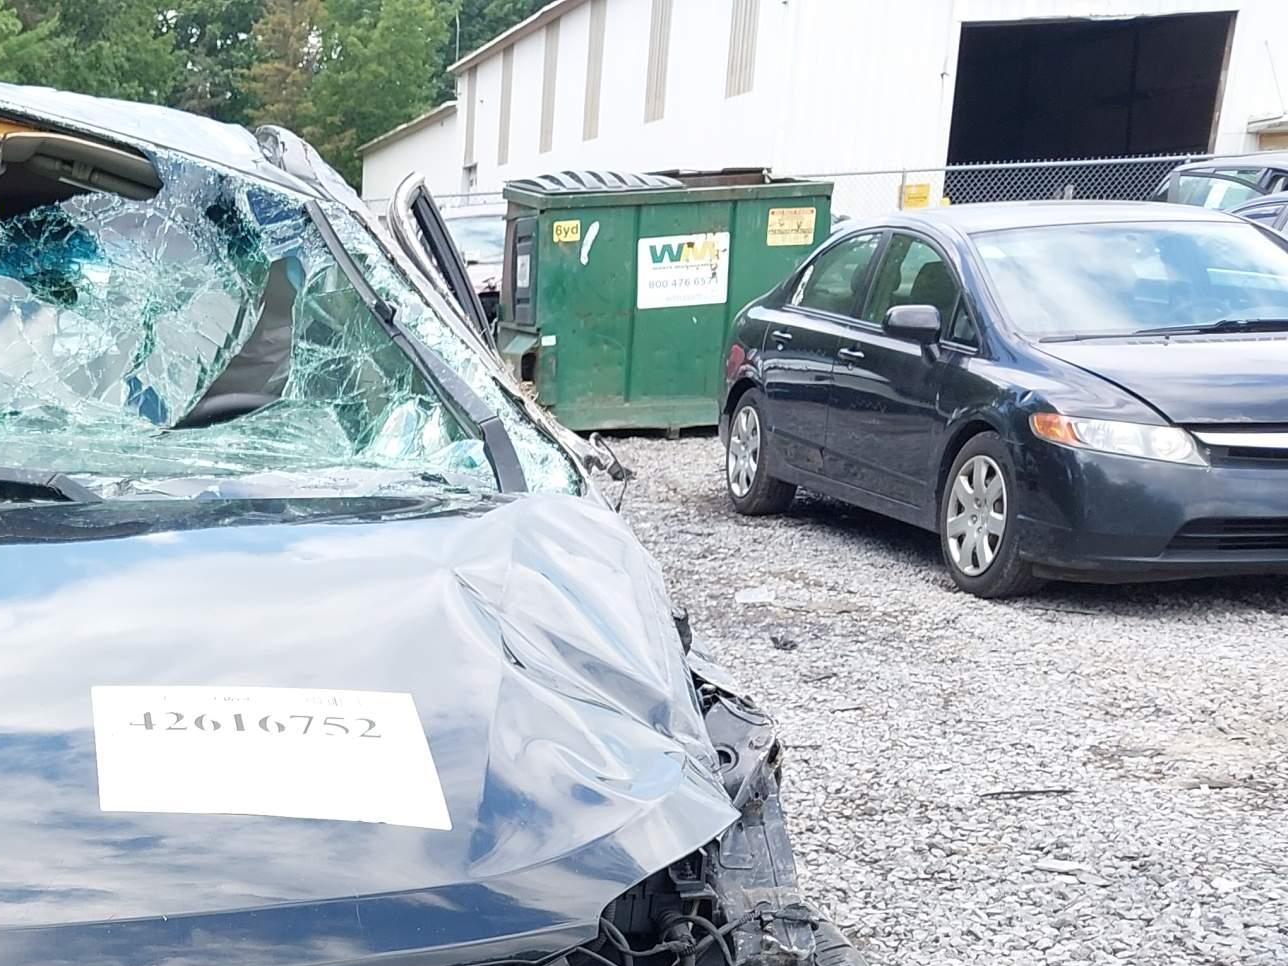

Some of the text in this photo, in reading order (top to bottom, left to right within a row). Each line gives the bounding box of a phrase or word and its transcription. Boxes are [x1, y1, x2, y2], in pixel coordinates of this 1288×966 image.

[556, 225, 579, 238] 6yd
[649, 280, 668, 289] 800
[672, 278, 690, 288] 476
[129, 711, 382, 739] 42616752
